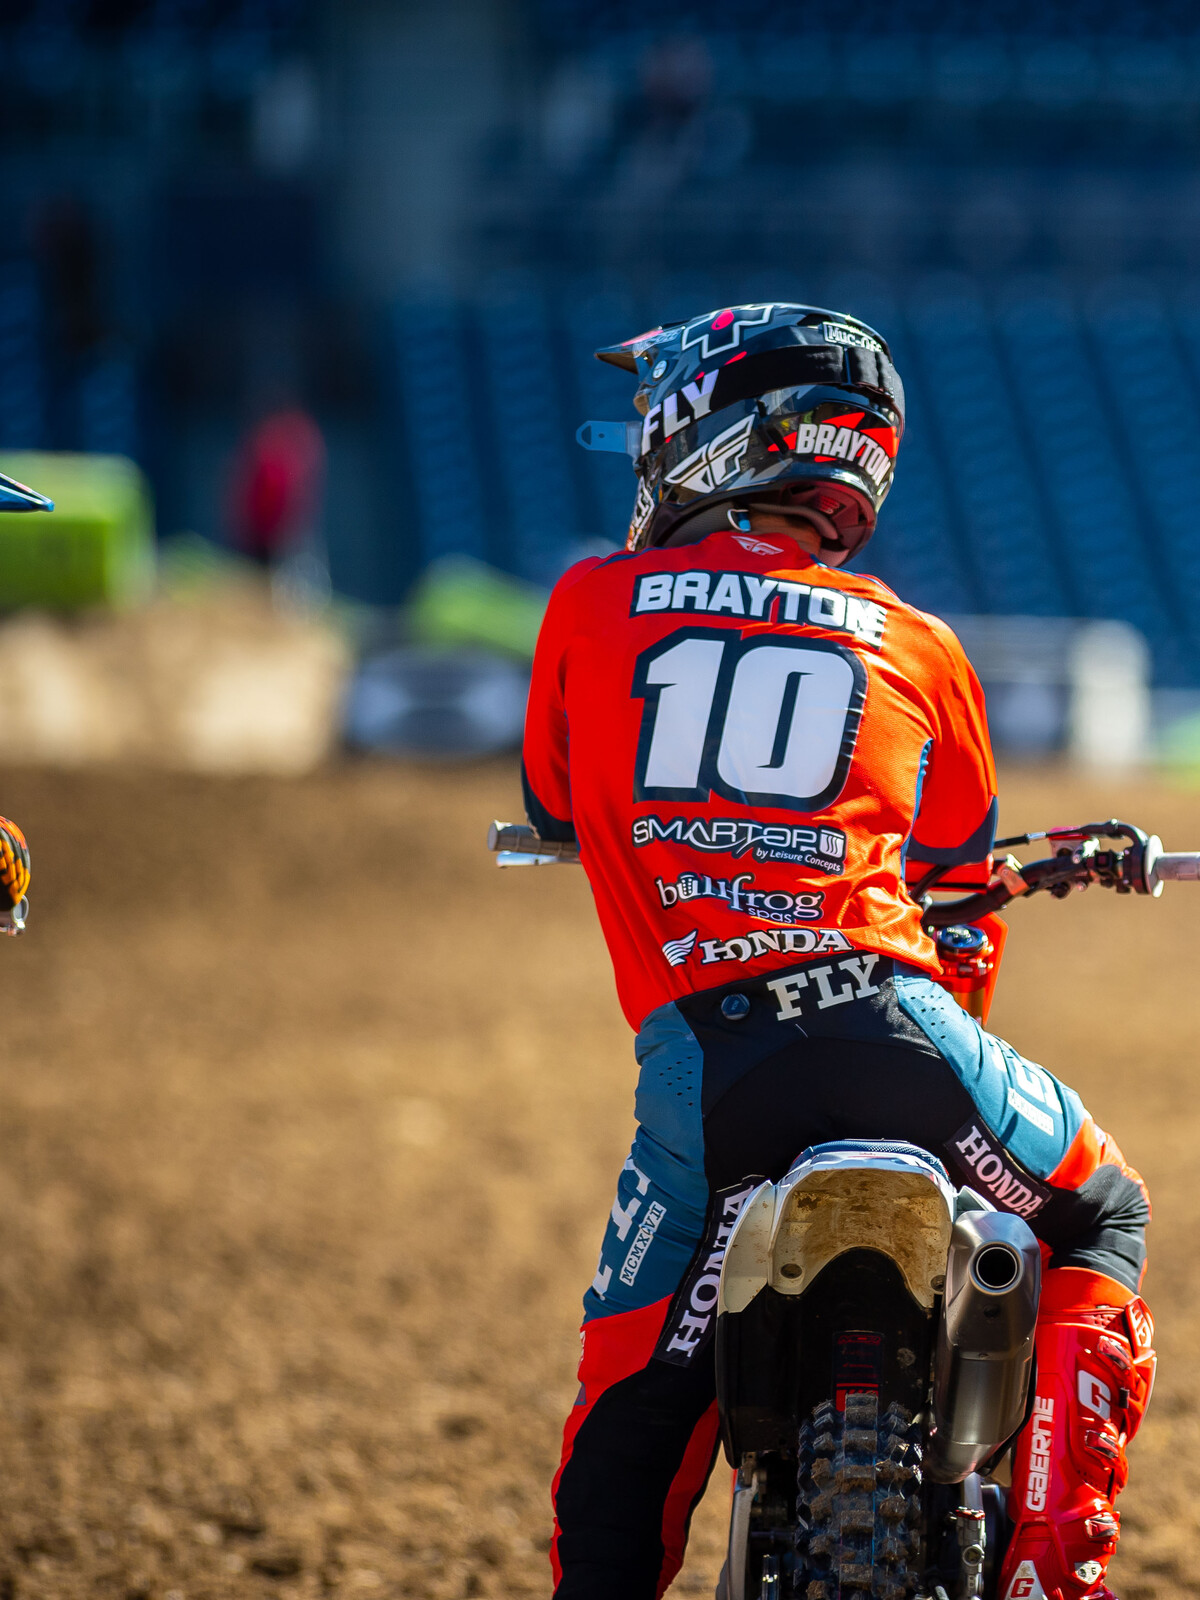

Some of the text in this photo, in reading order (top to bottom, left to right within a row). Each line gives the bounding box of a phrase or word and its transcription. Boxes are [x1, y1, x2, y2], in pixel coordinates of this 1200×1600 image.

[641, 369, 719, 456] FLY
[796, 423, 892, 487] BRAYTON
[635, 571, 888, 651] BRAYTON
[643, 638, 855, 799] 10
[755, 848, 841, 872] by Leisure Concepts
[699, 928, 854, 964] HONDA
[748, 907, 792, 924] spas
[766, 953, 880, 1021] FLY
[955, 1125, 1044, 1218] HONDA
